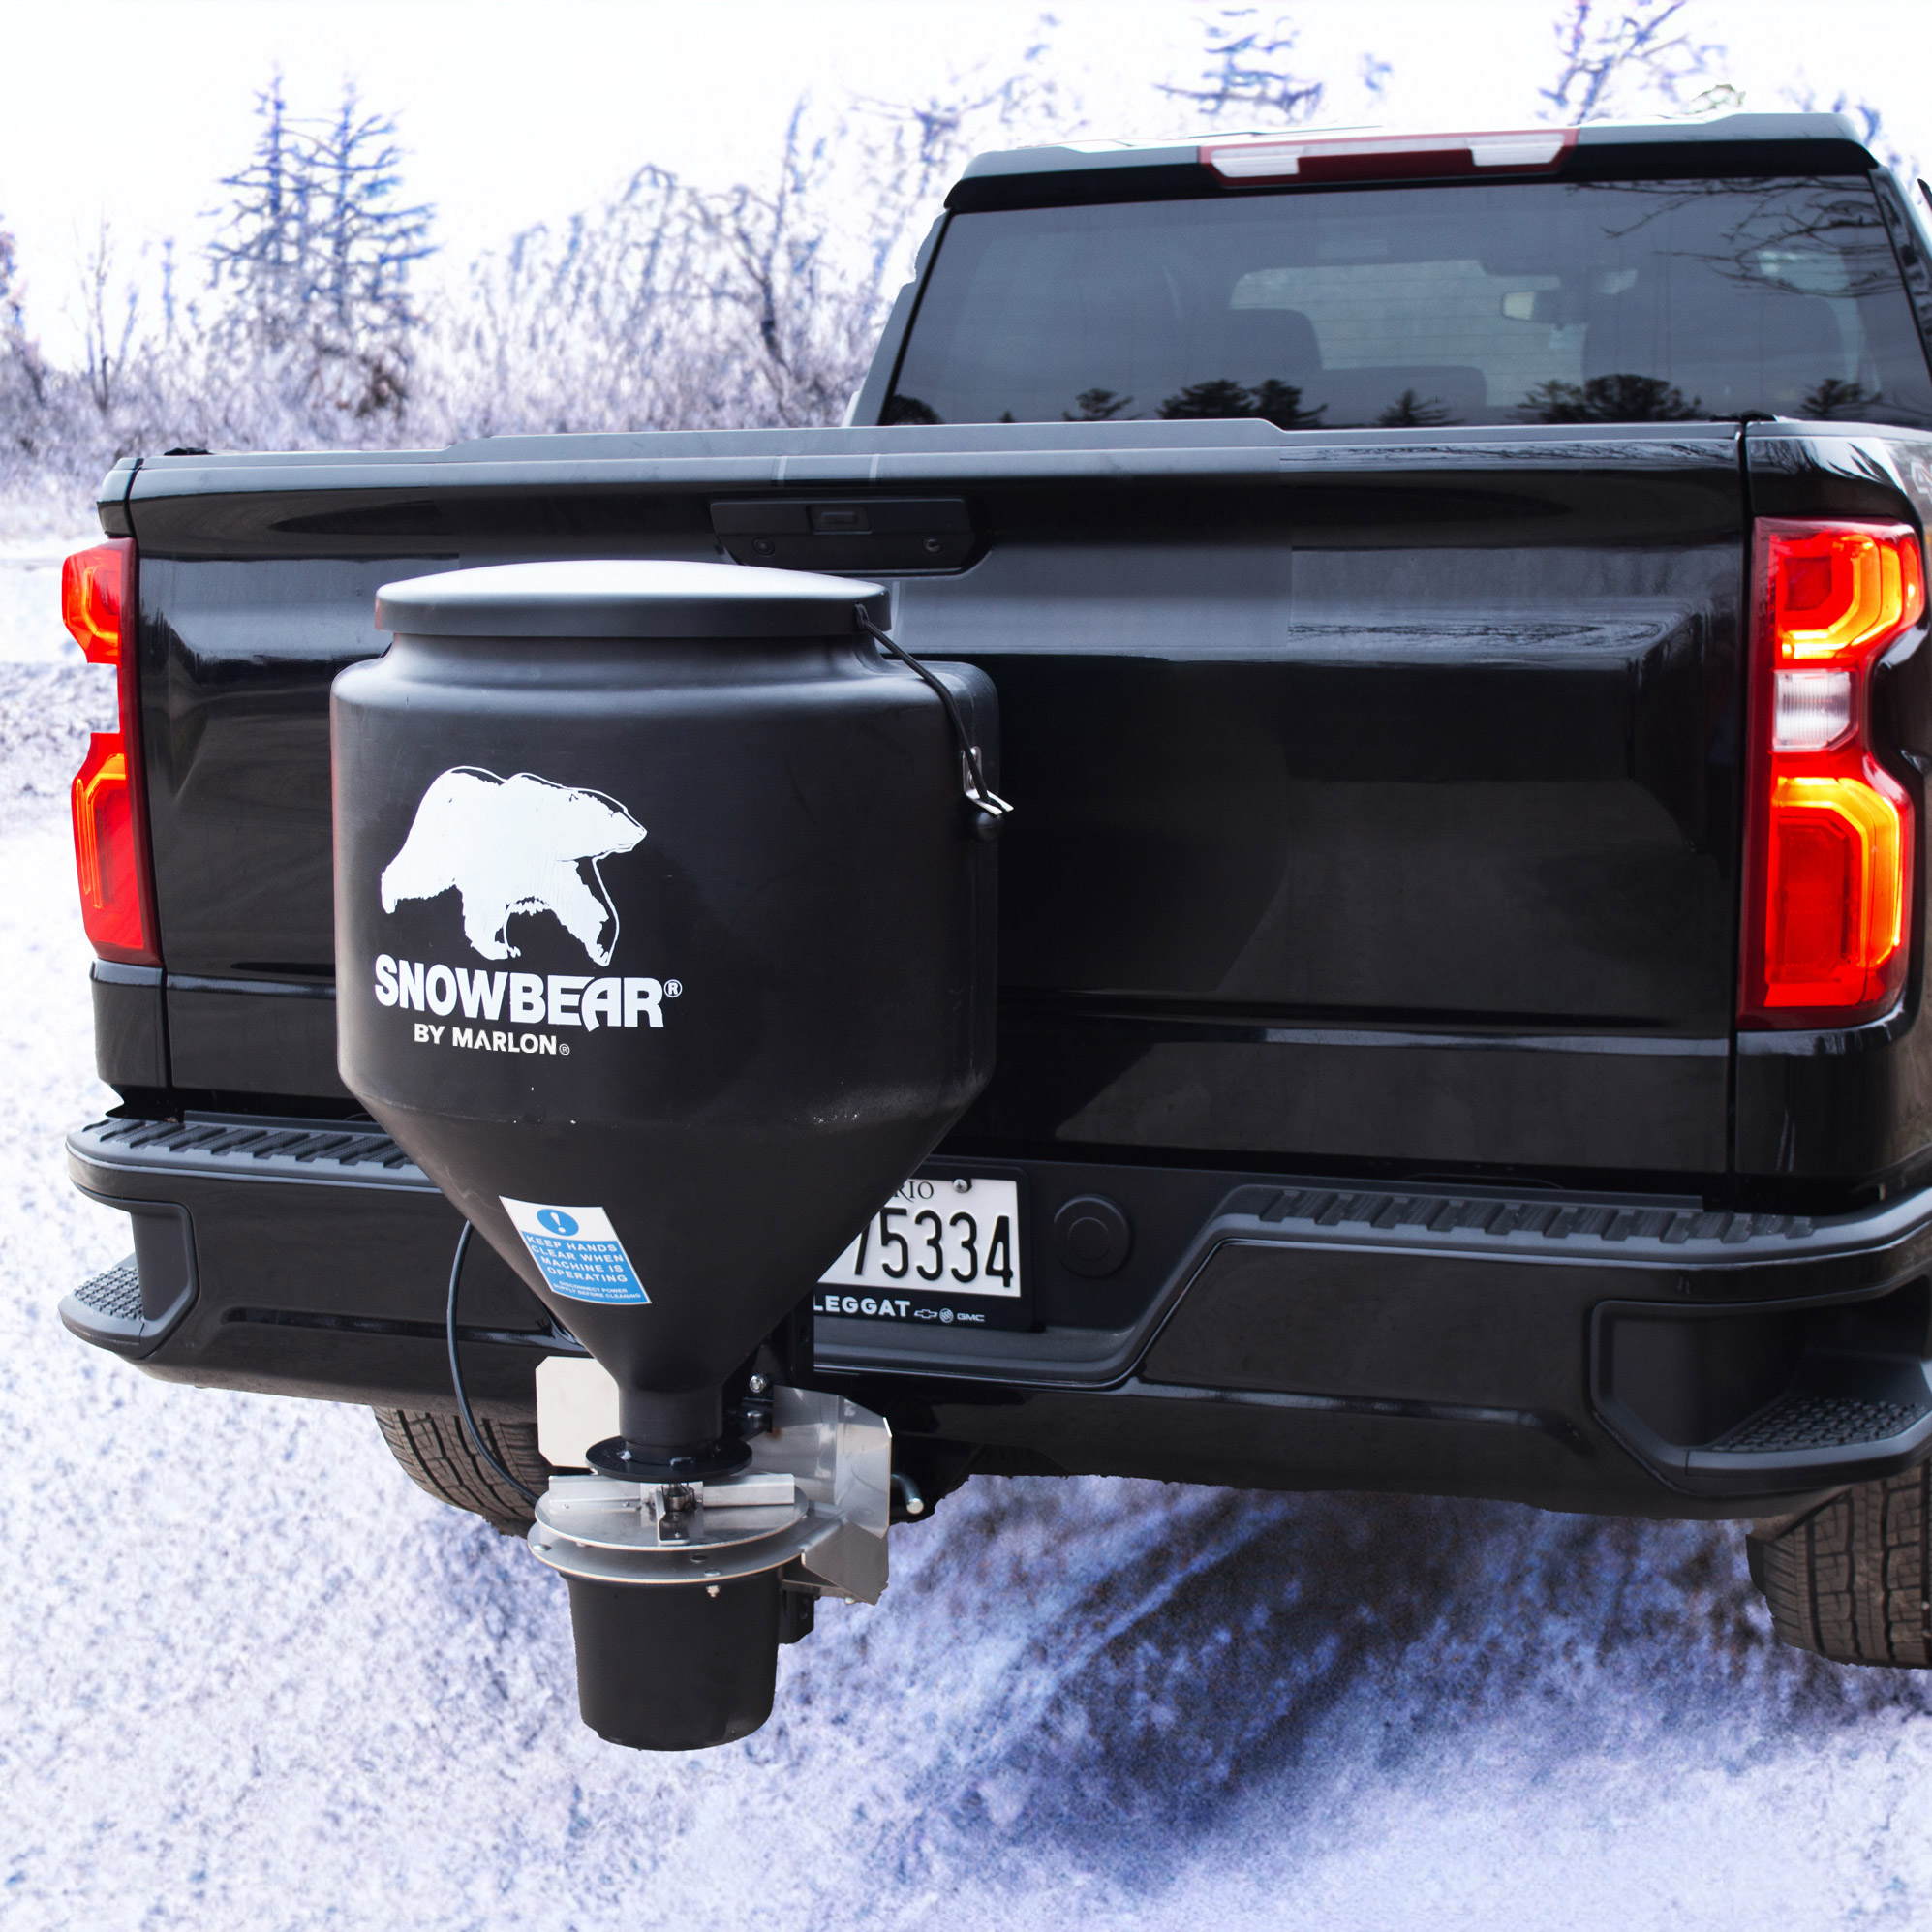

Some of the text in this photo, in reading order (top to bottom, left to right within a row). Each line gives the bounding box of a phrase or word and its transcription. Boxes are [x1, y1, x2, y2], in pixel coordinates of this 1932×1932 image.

[414, 1023, 445, 1044] BY
[526, 1235, 618, 1252] KEEP HANDS
[531, 1245, 625, 1263] CLEAR WHEN
[540, 1255, 604, 1273] MACHINE
[547, 1267, 629, 1283] OPERATING
[577, 1289, 605, 1299] BEFORE
[957, 1312, 985, 1322] GMC
